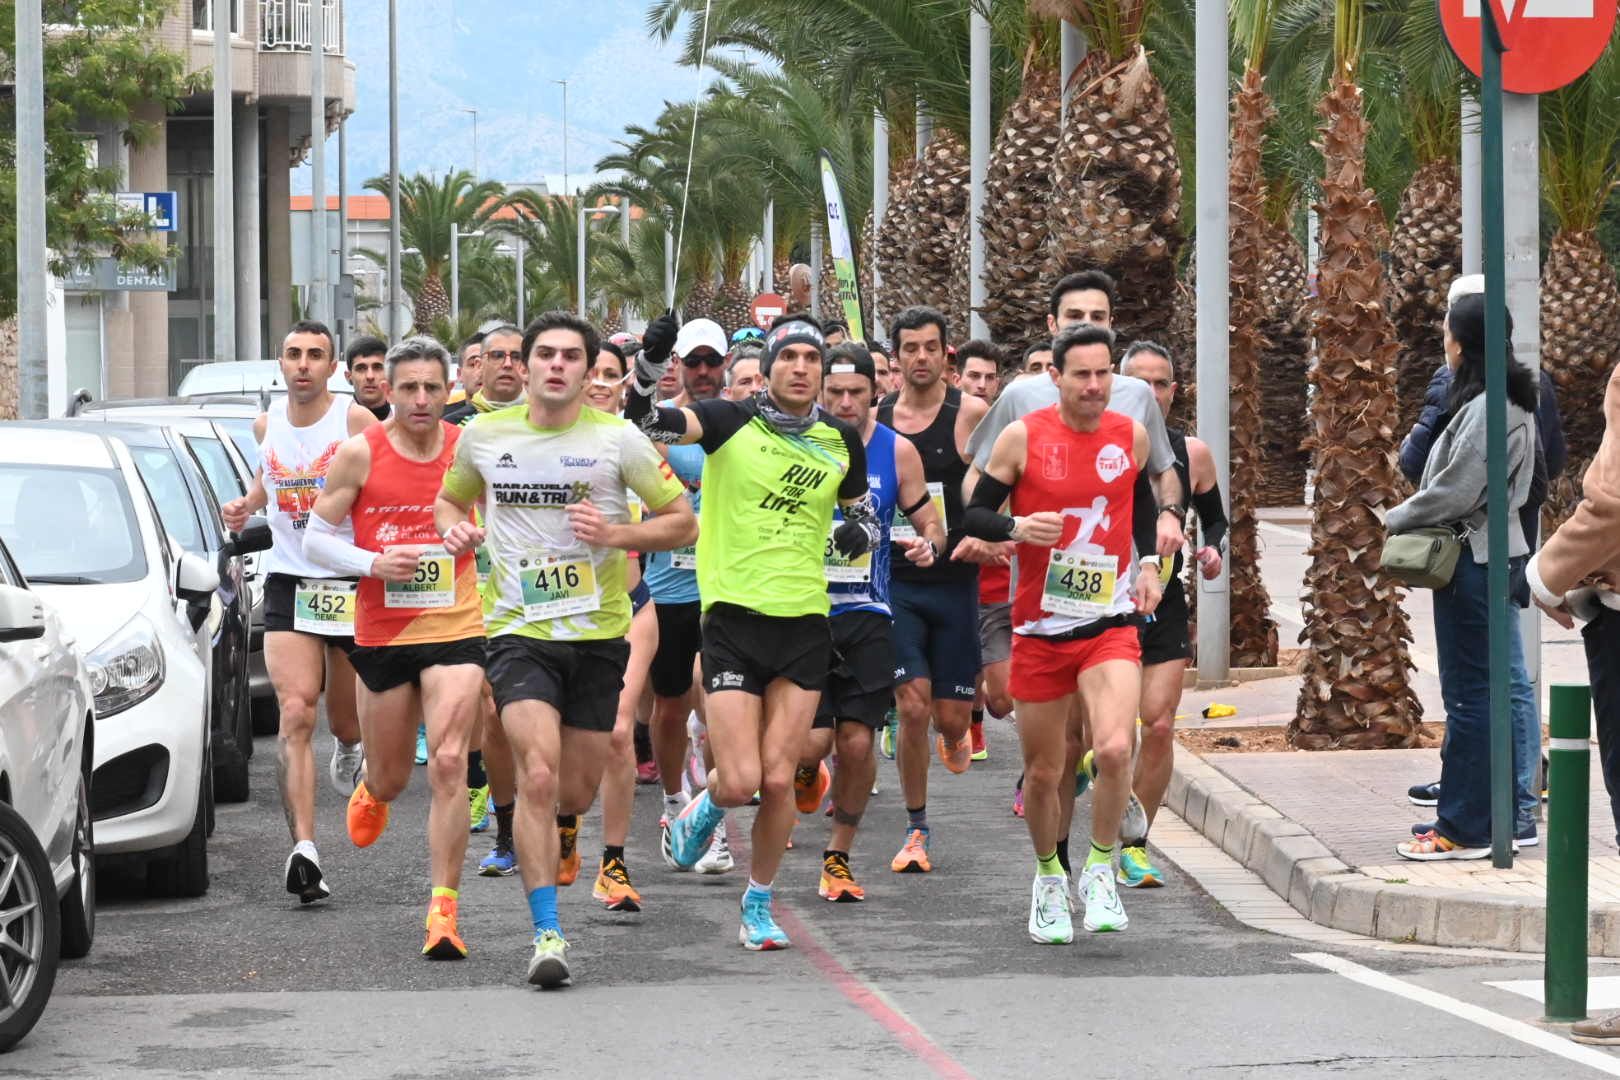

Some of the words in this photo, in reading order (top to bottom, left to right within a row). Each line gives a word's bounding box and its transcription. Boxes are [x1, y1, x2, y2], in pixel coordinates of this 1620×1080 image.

[116, 276, 166, 286] DENTAL
[780, 463, 828, 490] RUN
[492, 482, 573, 490] MARAZUELA
[780, 485, 806, 499] FOR
[759, 491, 808, 515] LIFE
[535, 564, 579, 592] 416
[1060, 568, 1102, 594] 438
[402, 583, 438, 592] ALBERT
[550, 590, 569, 600] JAVI
[307, 593, 346, 613] 452
